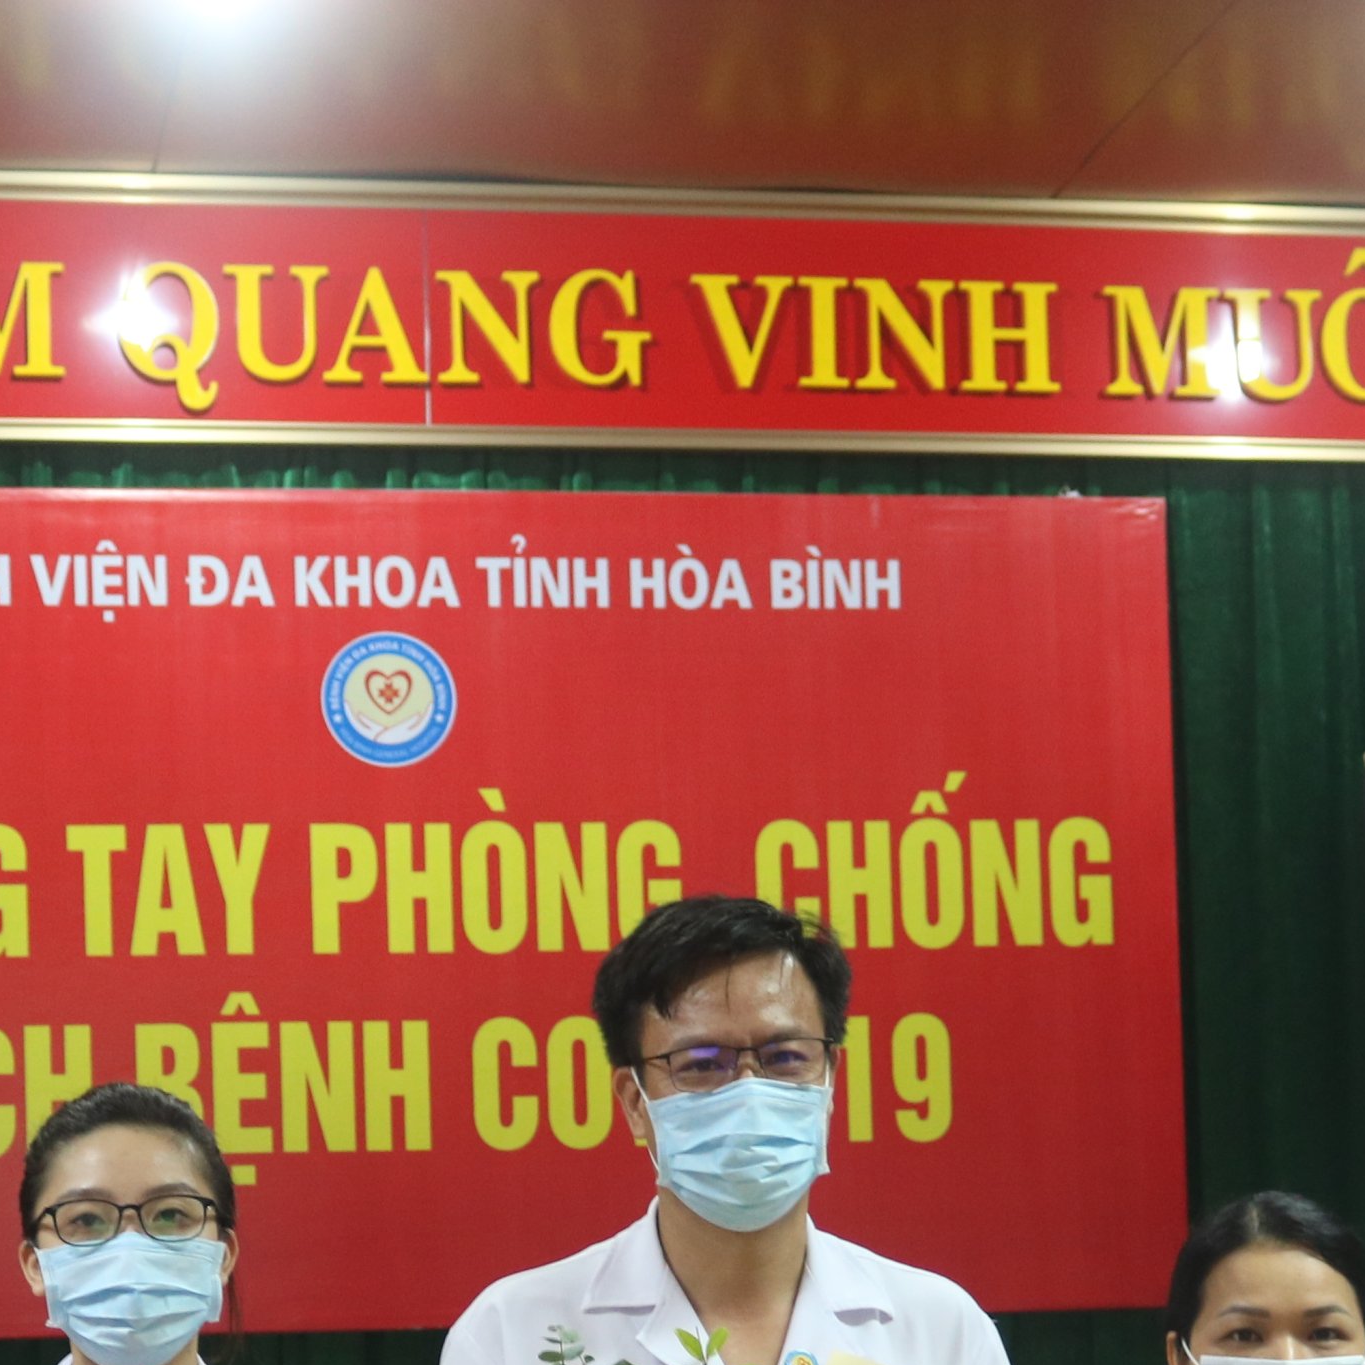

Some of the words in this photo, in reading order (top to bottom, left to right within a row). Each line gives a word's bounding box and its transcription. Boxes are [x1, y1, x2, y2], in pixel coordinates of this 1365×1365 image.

[119, 262, 652, 412] QUANG
[691, 274, 1061, 393] VINH
[30, 539, 169, 623] VIỆN
[185, 554, 275, 607] ĐA
[293, 554, 461, 609] KHOA
[475, 533, 611, 609] TỈNH
[629, 544, 753, 610] HÒA
[770, 545, 902, 610] BÌNH
[66, 823, 271, 957] TAY
[310, 787, 683, 955] PHÒNG
[754, 771, 1115, 951] CHỐNG
